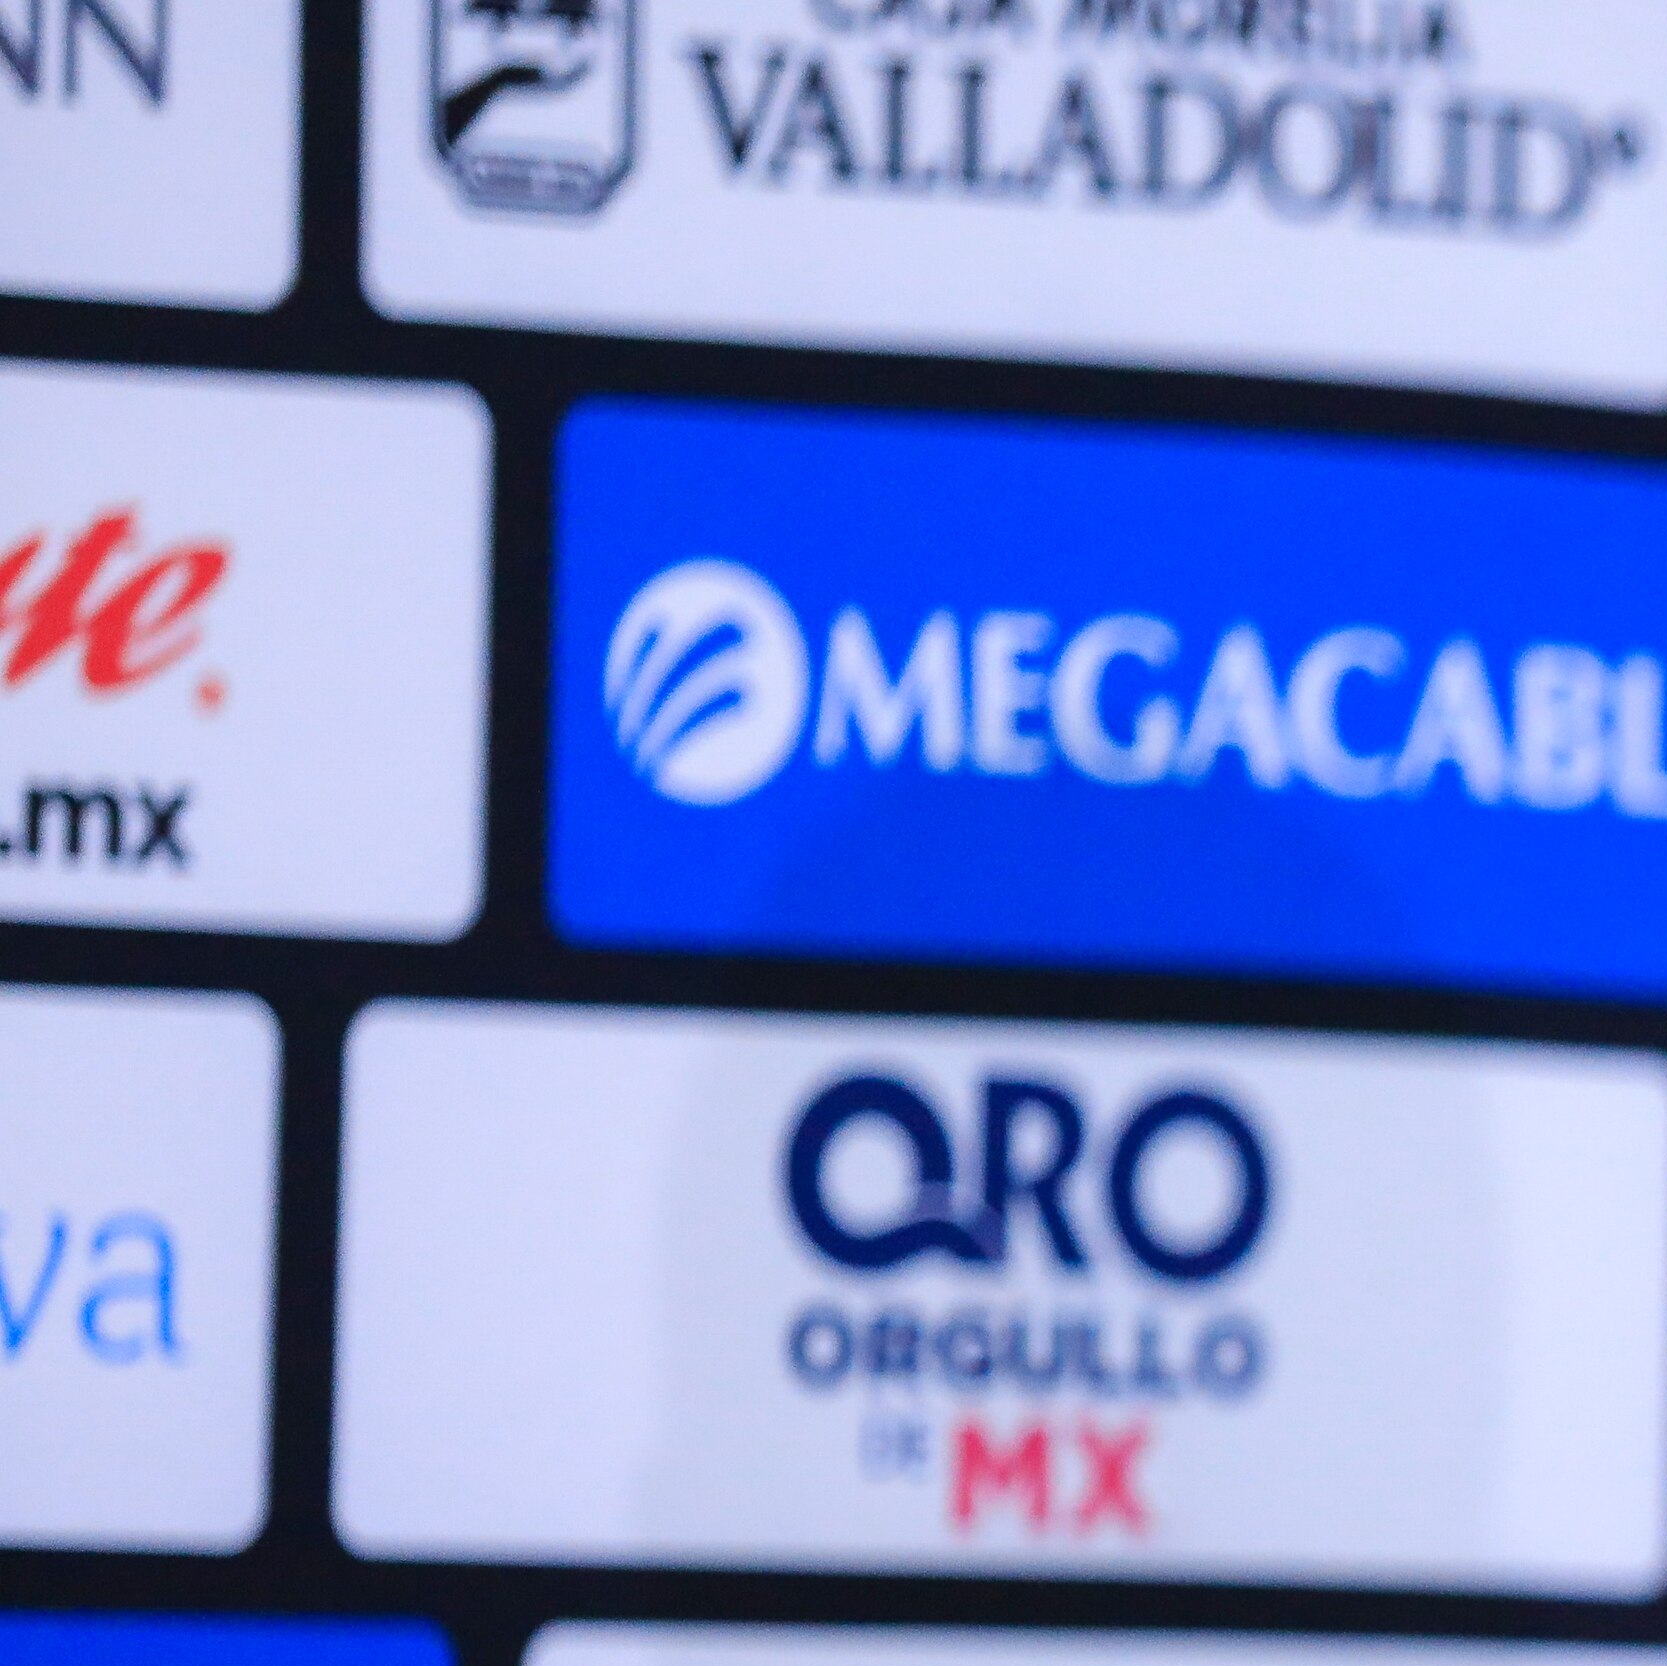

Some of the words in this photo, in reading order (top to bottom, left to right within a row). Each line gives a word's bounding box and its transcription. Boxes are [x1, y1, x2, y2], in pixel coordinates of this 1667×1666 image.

[785, 1068, 1274, 1284] QRO
[788, 1304, 1266, 1404] ORGULLO
[948, 1408, 1154, 1538] MX
